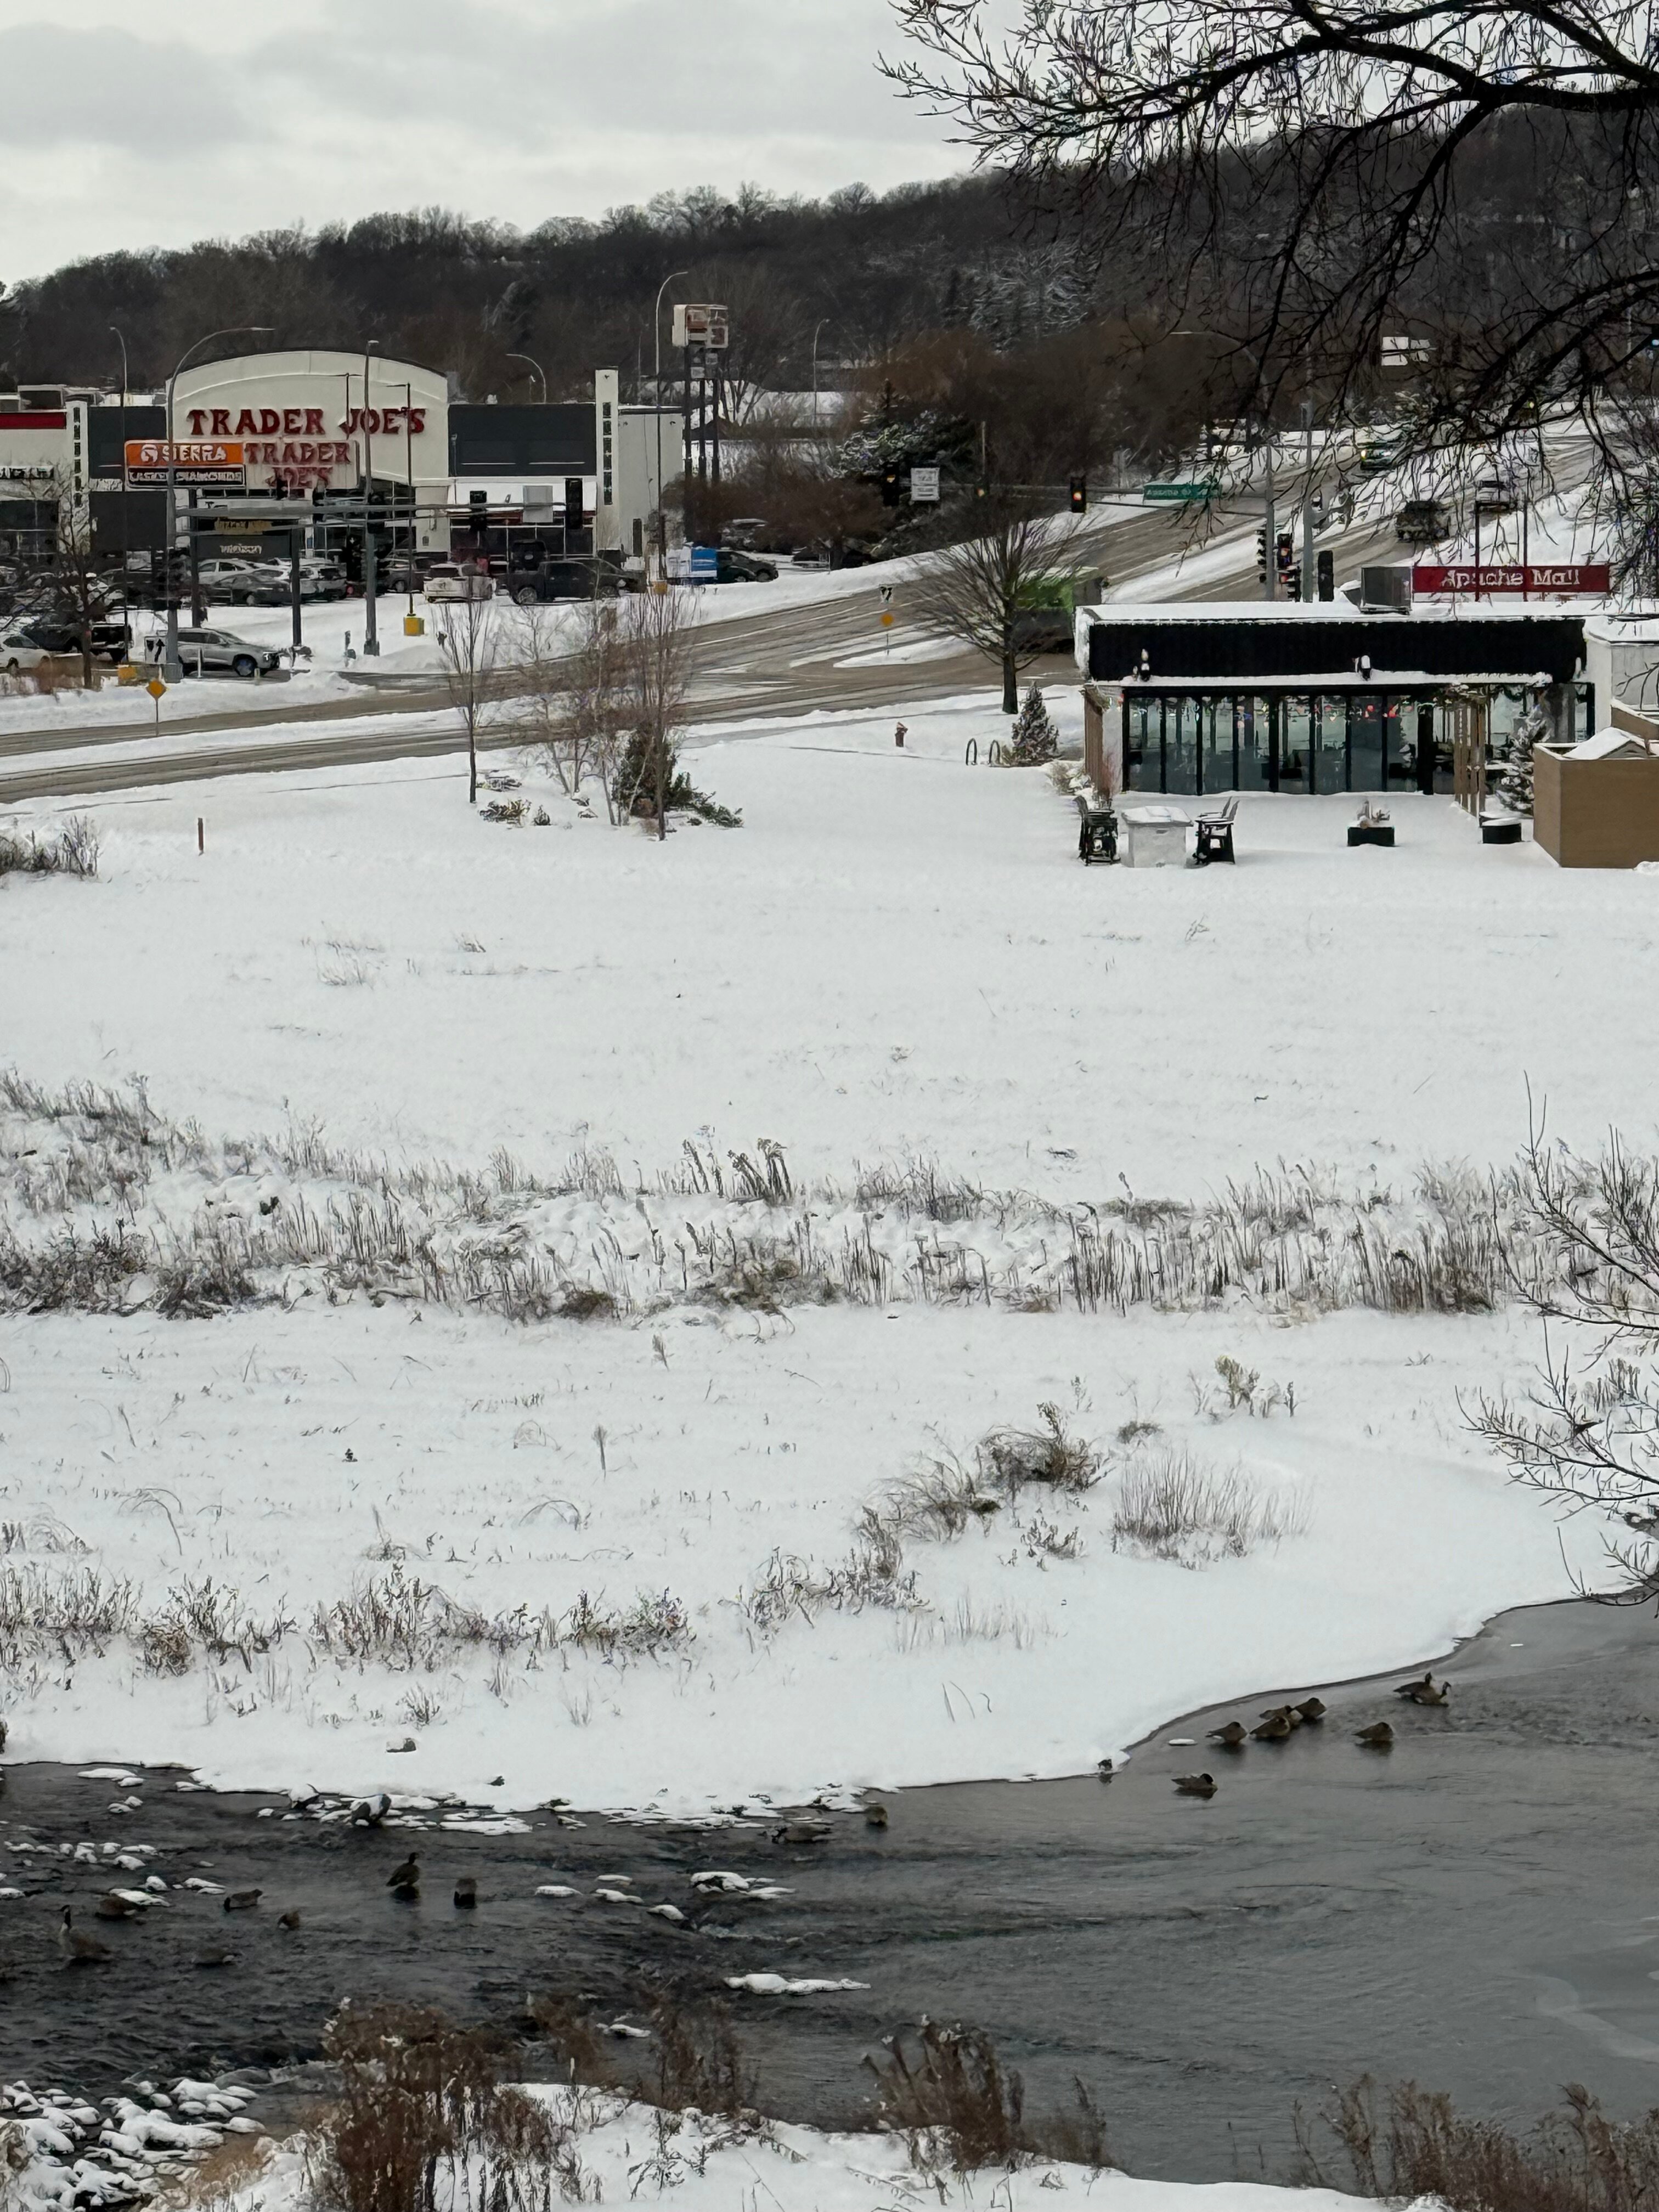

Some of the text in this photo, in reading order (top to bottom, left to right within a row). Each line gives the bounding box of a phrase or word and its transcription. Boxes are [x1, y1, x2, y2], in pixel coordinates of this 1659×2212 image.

[187, 408, 427, 436] TRADER JOE'S
[162, 444, 227, 462] SIERRA
[245, 442, 351, 465] TRADER
[1532, 568, 1581, 586] Mall
